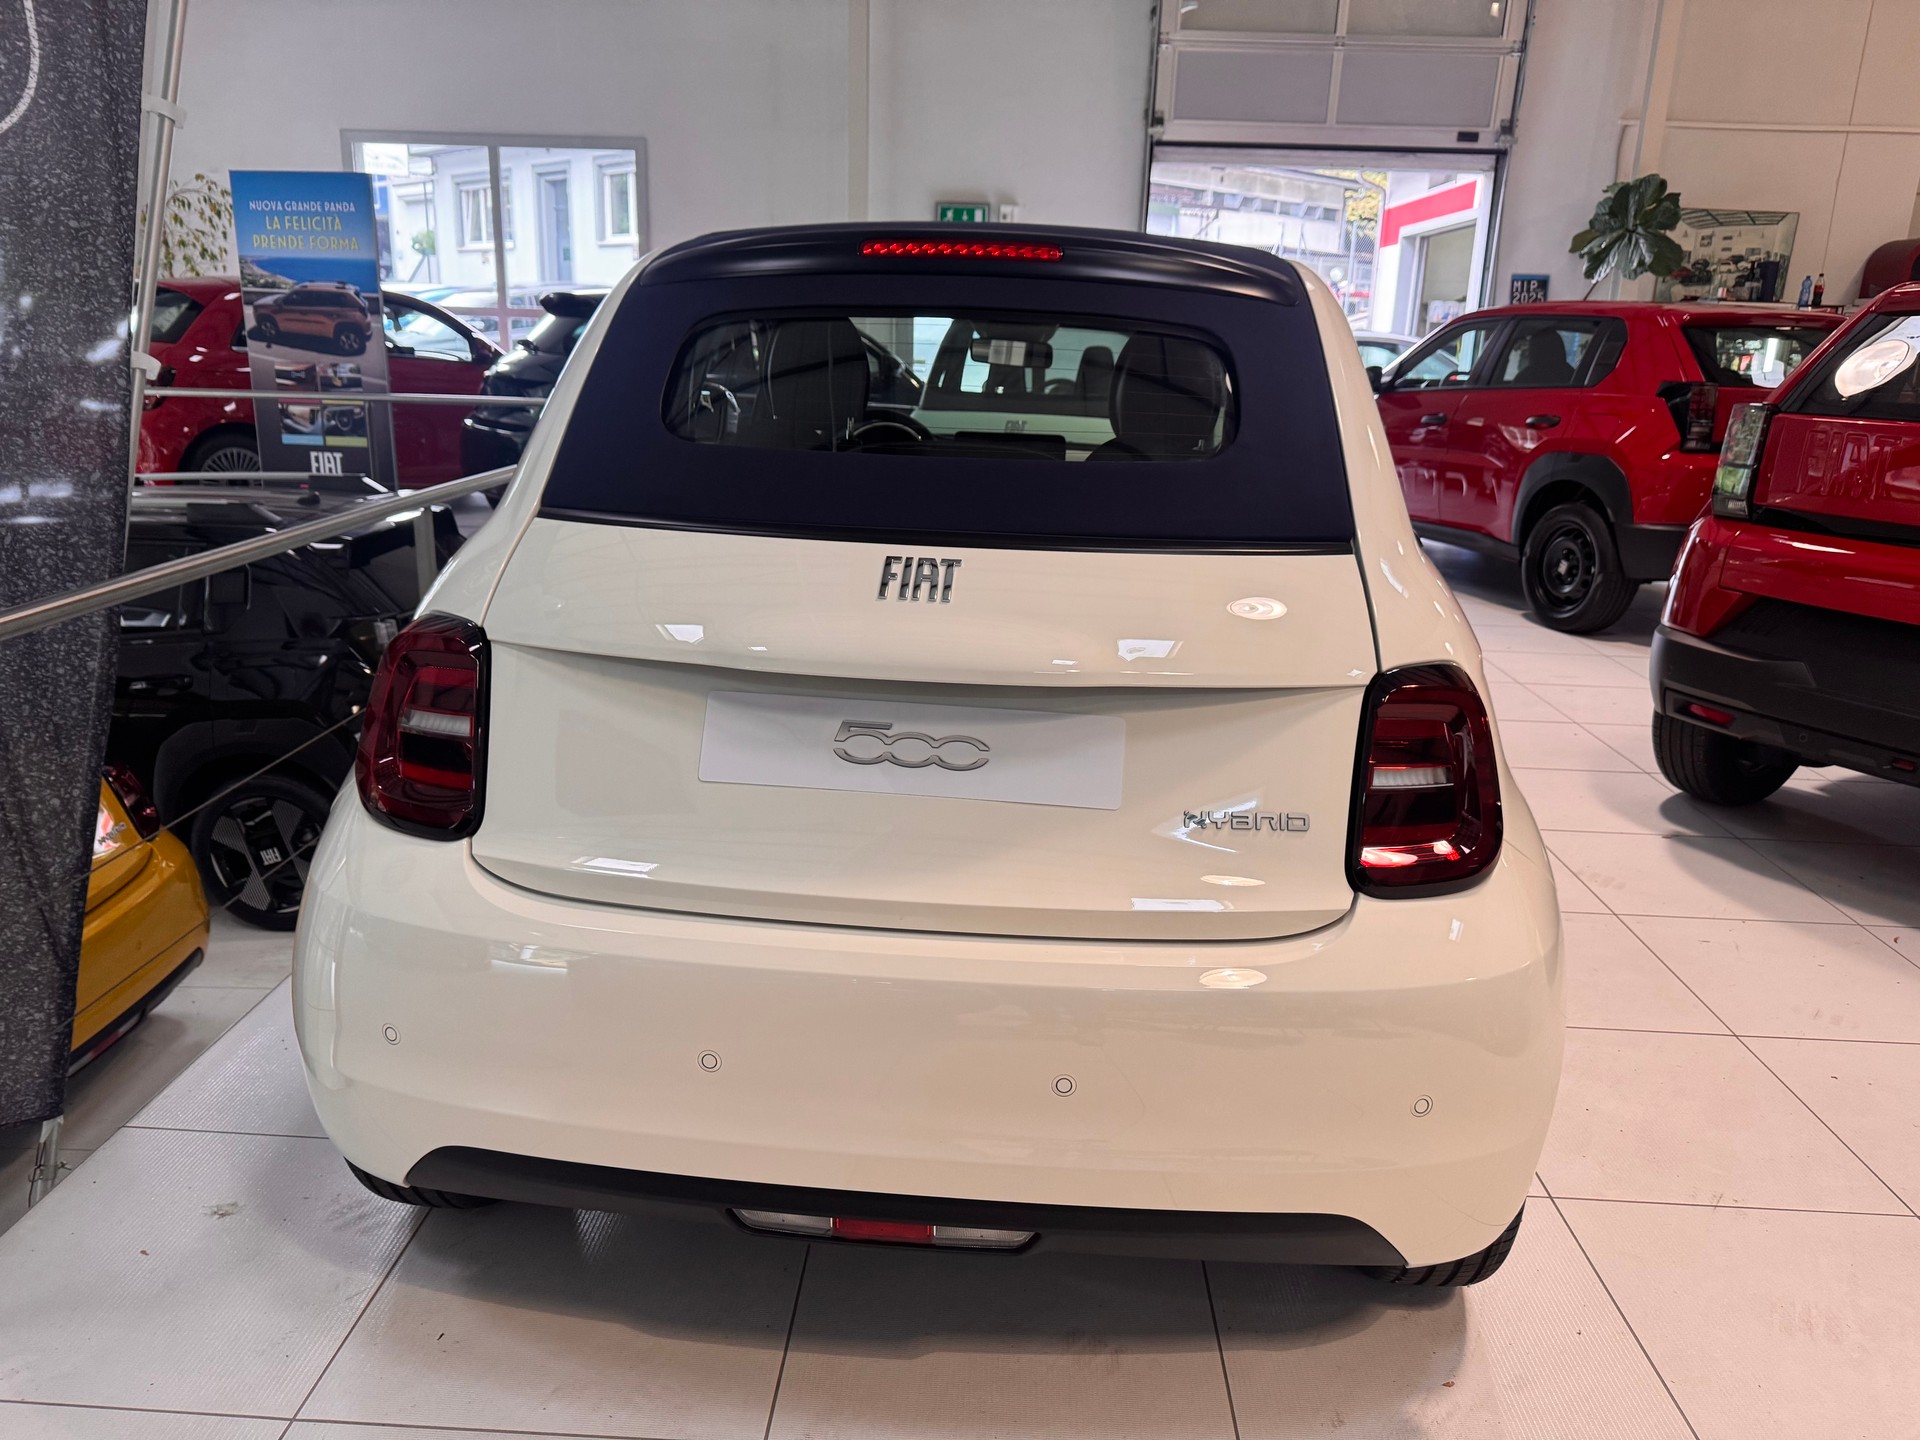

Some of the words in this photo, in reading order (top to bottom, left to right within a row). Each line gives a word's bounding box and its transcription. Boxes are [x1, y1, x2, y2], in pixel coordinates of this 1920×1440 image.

[249, 200, 282, 211] NUOVA
[284, 201, 322, 212] GRANDE
[324, 202, 356, 213] PANDA
[266, 216, 280, 230] LA
[285, 214, 342, 231] FELICITÀ
[253, 234, 305, 250] PRENDE
[309, 235, 359, 251] FORMA
[1512, 291, 1545, 304] 2025
[310, 451, 344, 476] FIAT
[1796, 430, 1903, 500] FIAT
[878, 555, 962, 603] FIAT
[833, 719, 991, 771] 500
[1183, 810, 1310, 832] HYBRID
